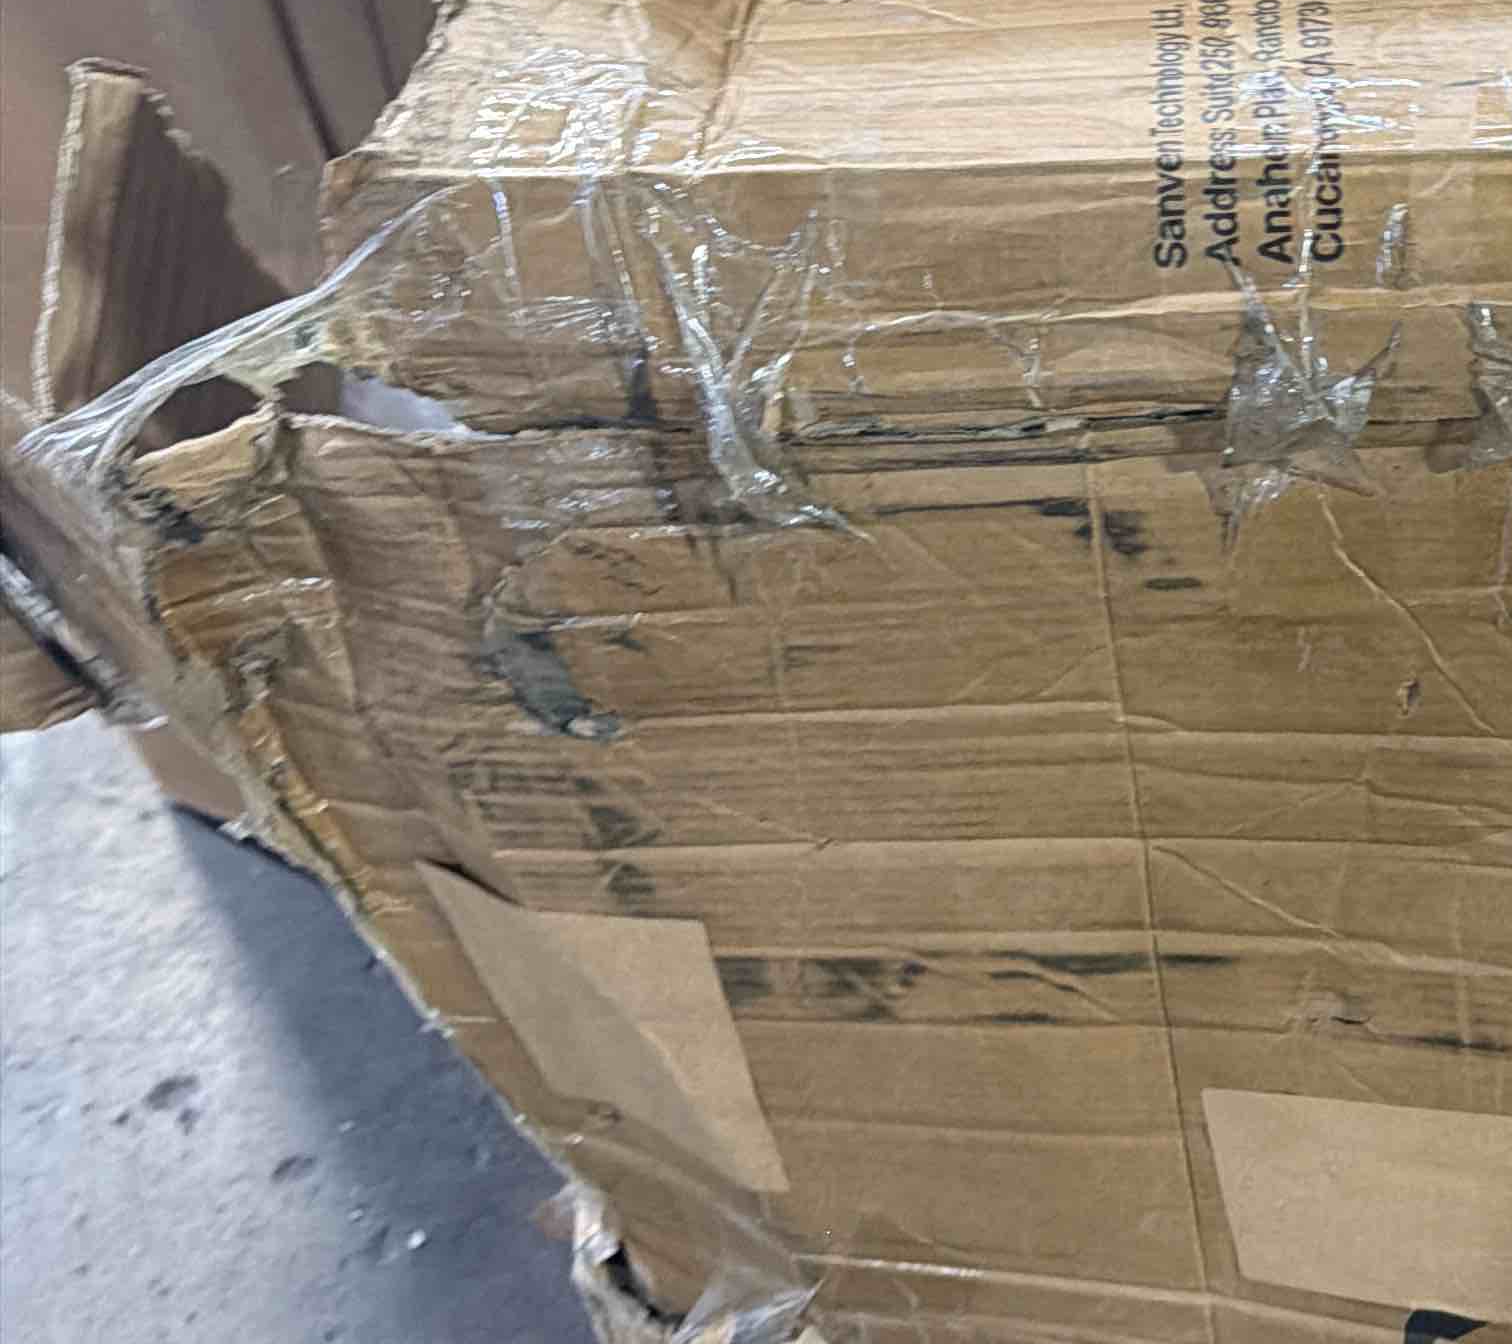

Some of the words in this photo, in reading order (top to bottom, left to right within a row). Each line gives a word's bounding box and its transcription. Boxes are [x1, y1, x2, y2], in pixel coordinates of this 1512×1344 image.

[1149, 32, 1190, 136] Technology
[1199, 74, 1235, 124] Suite
[1304, 52, 1336, 77] CA
[1152, 141, 1188, 269] Sanven
[1256, 122, 1294, 265] Anaheim
